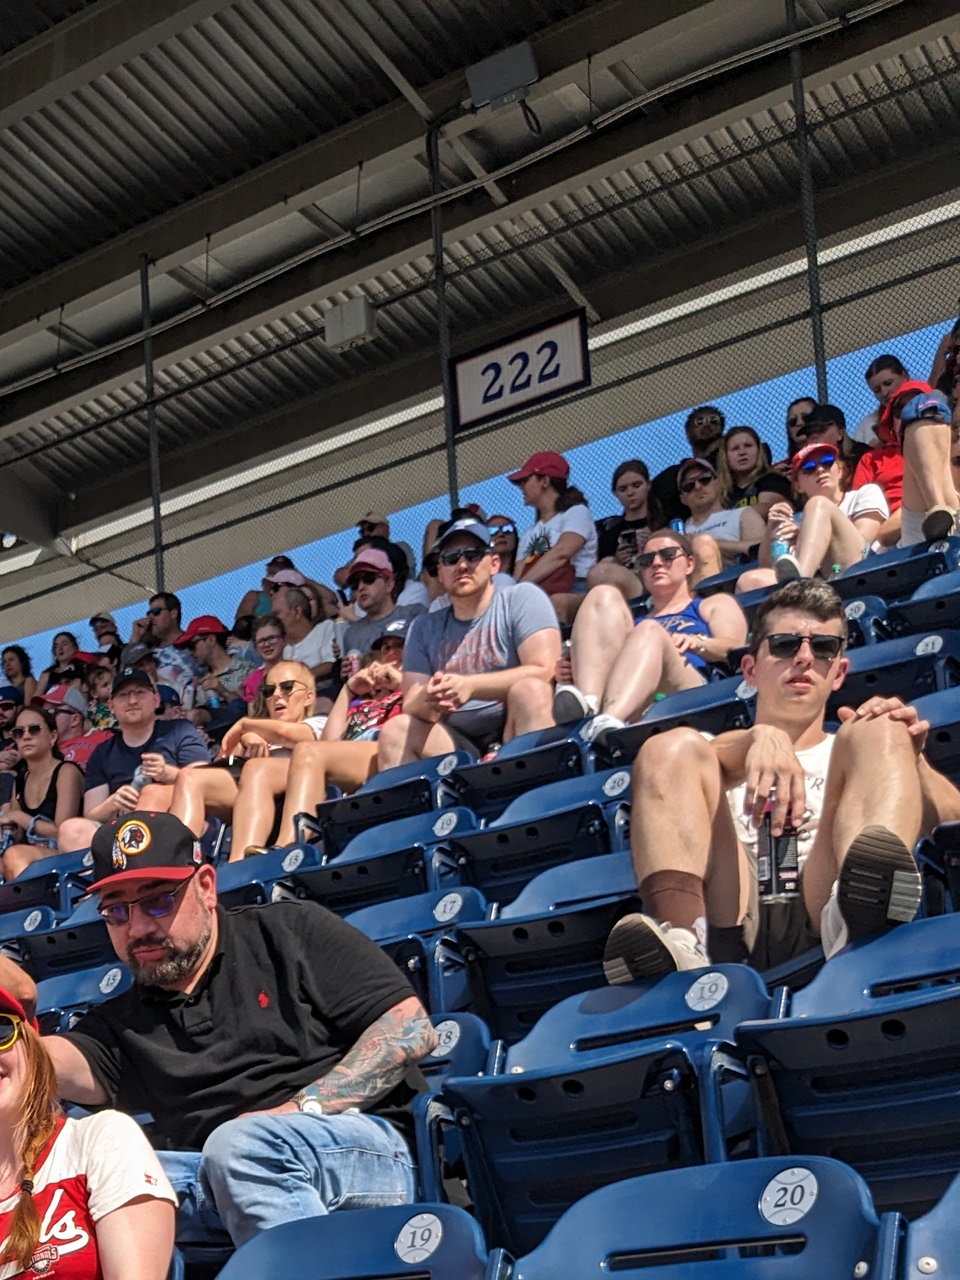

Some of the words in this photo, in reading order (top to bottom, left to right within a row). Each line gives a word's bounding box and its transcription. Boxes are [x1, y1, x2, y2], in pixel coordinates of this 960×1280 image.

[481, 340, 560, 404] 222
[442, 901, 456, 914] 17
[699, 983, 719, 999] 19
[773, 1184, 805, 1208] 20
[406, 1227, 432, 1249] 19
